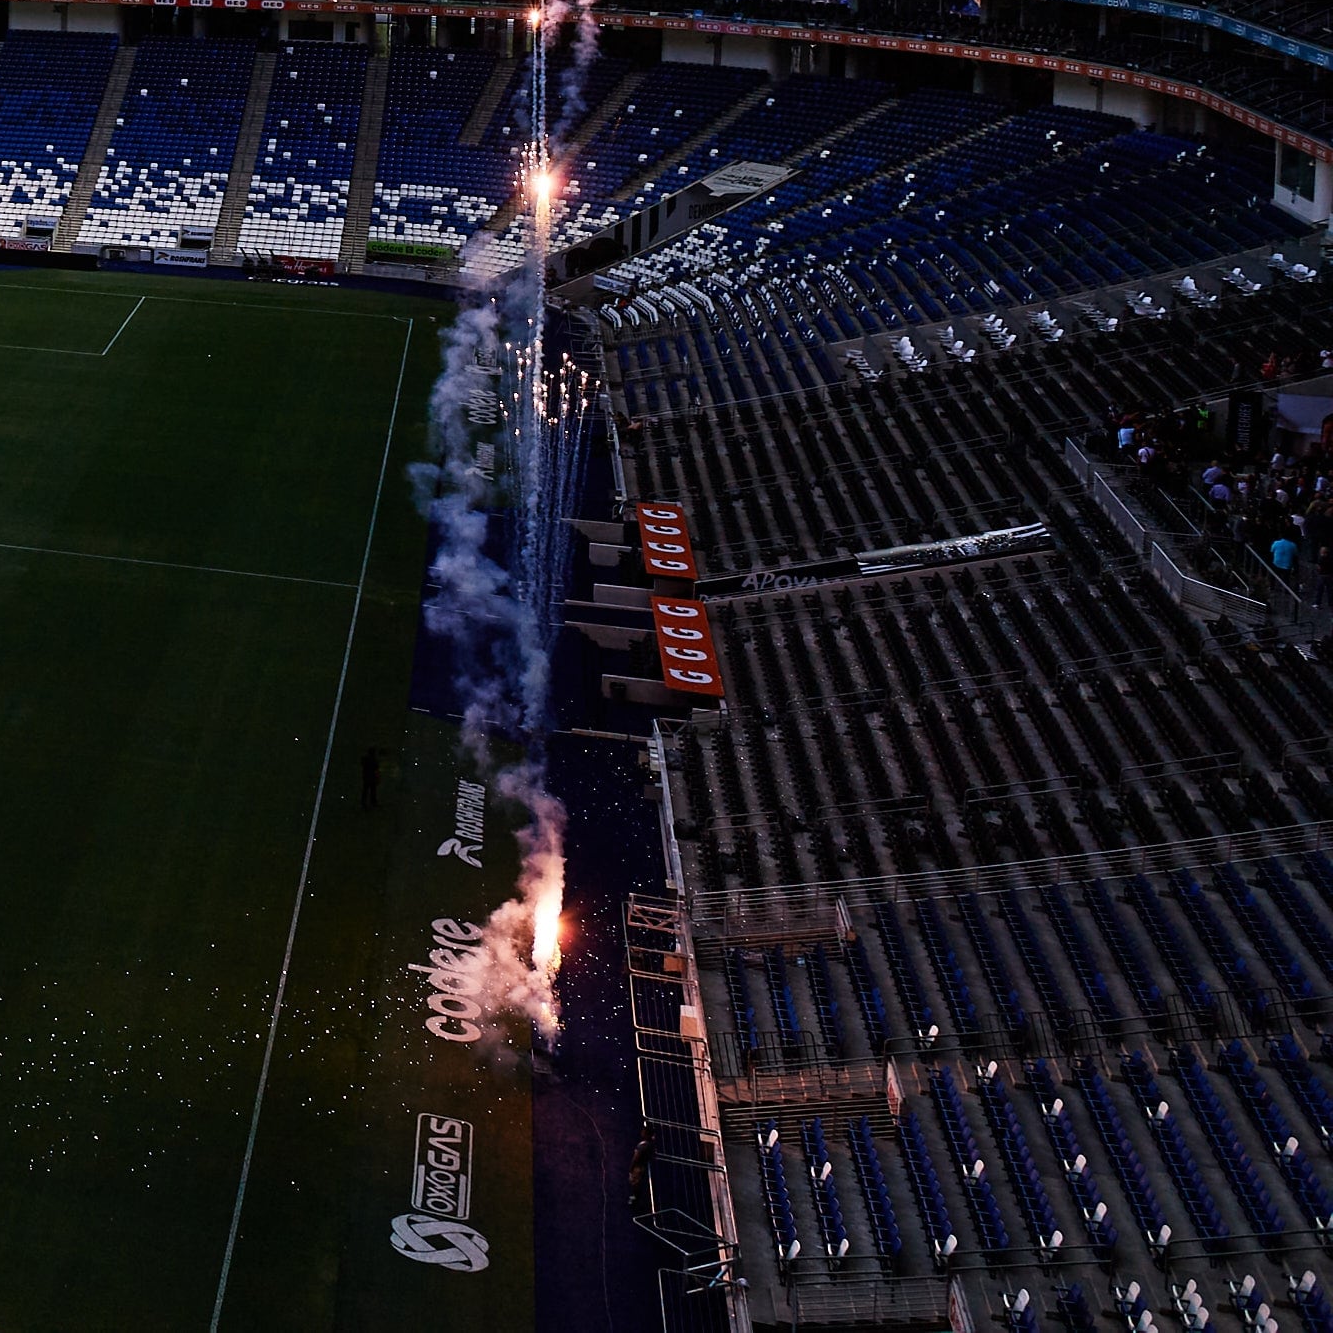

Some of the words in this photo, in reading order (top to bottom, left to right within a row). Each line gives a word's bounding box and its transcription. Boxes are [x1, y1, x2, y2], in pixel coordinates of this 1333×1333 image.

[371, 244, 403, 253] codere
[455, 780, 485, 842] ROSHFRANS
[408, 918, 483, 1043] codere
[426, 1117, 462, 1213] OXXOGAS
